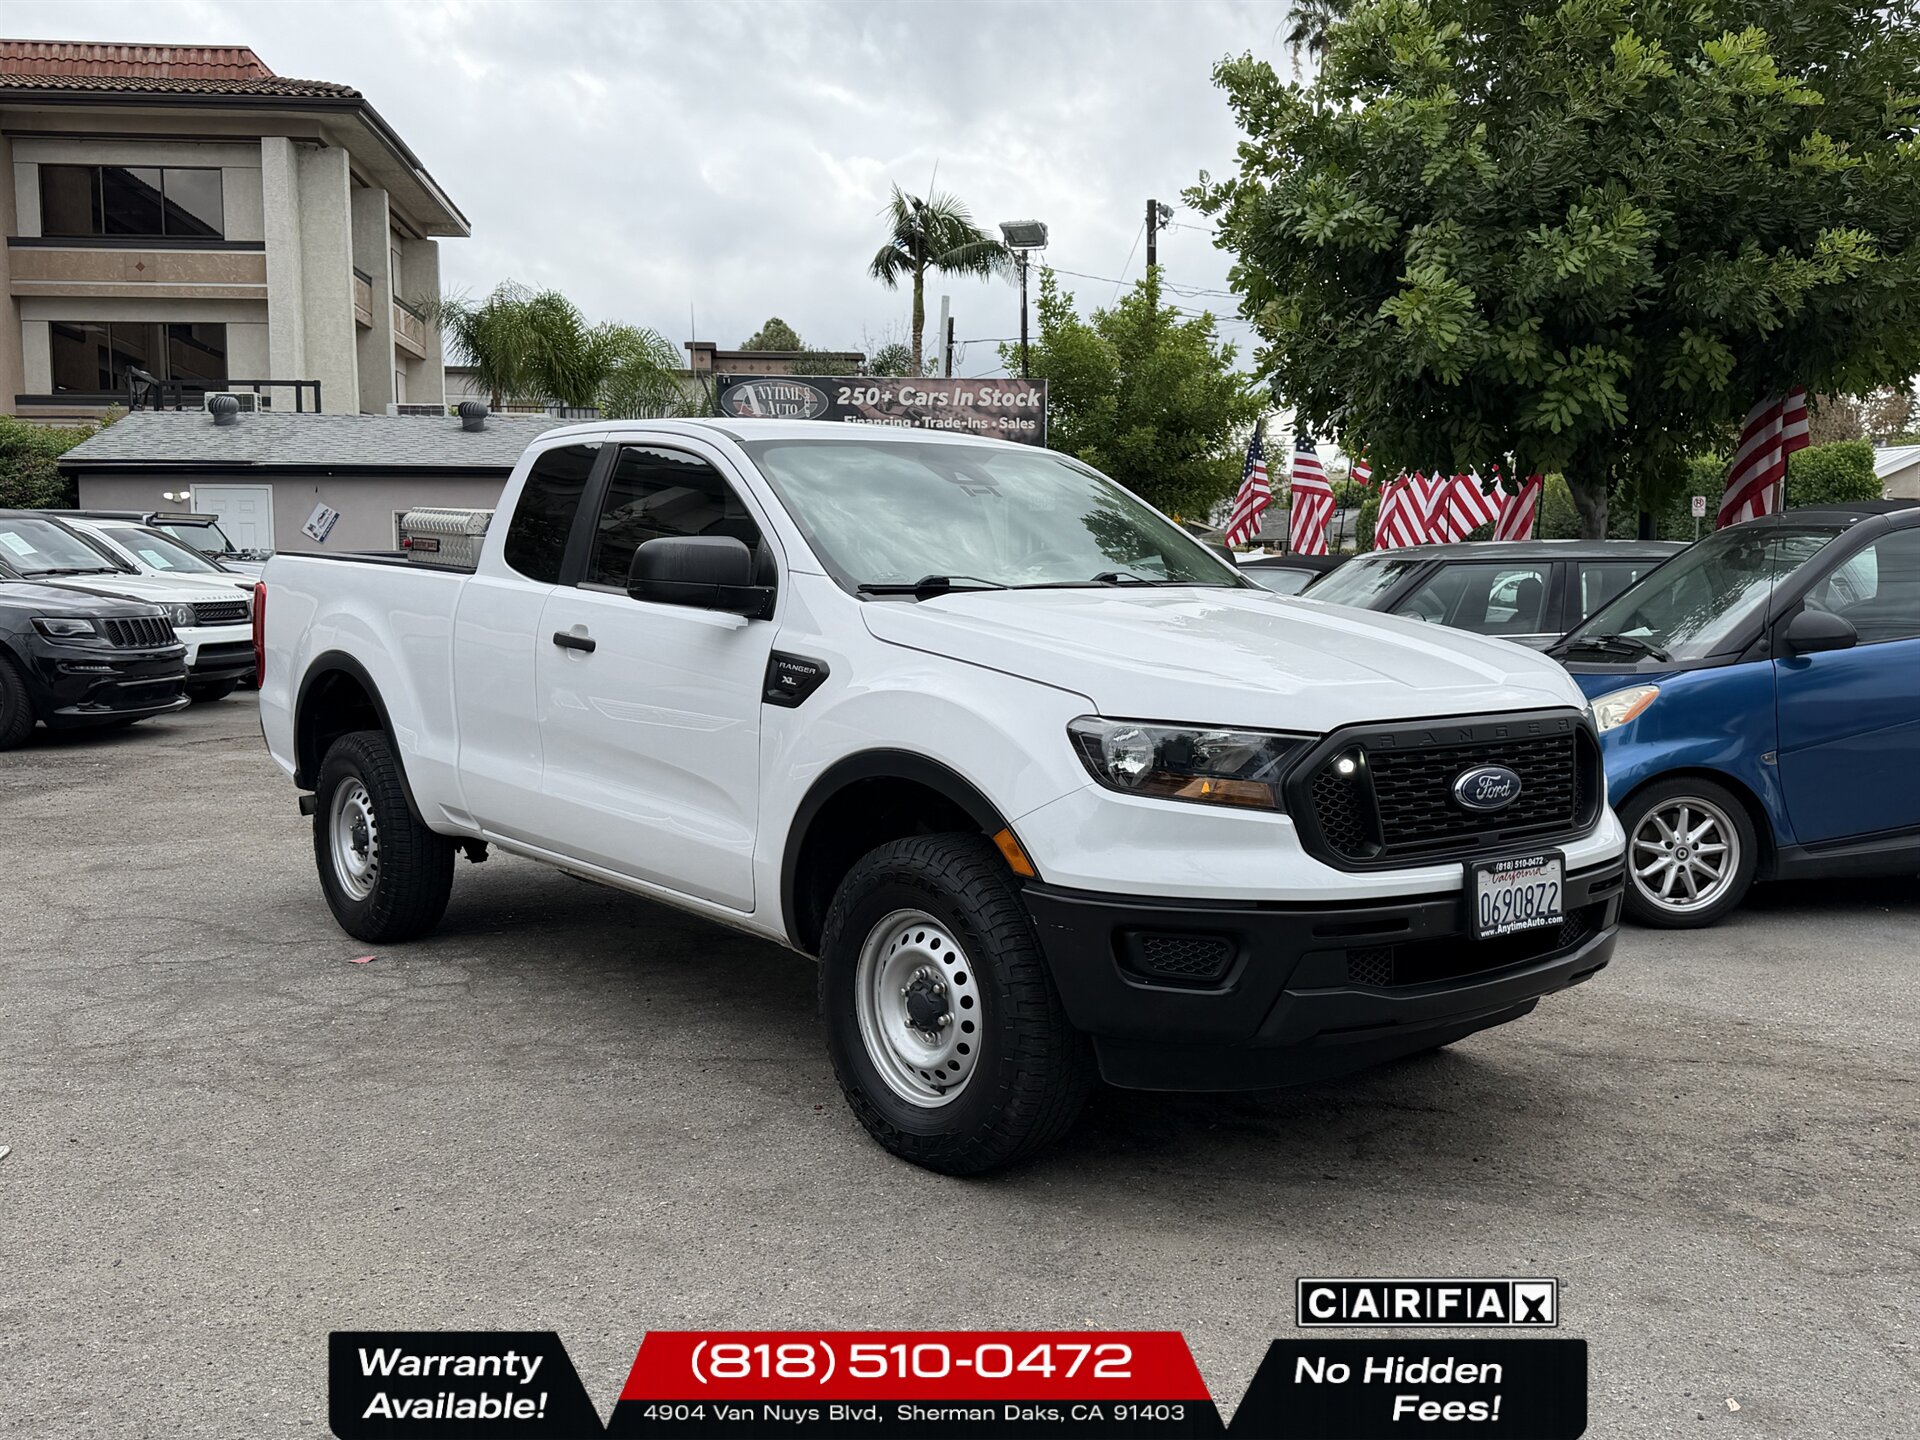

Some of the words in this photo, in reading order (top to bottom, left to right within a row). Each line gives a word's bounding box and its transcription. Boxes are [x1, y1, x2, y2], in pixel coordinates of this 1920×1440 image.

[837, 386, 893, 406] 250+
[899, 386, 949, 406] Cars
[953, 387, 973, 406] In
[977, 387, 1041, 407] Stock
[767, 401, 798, 415] AUTO
[922, 417, 988, 429] Trade-Ins
[999, 417, 1036, 429] Sales
[778, 662, 816, 675] RANGER
[781, 675, 797, 686] XL
[1378, 718, 1570, 748] RANGER
[1476, 775, 1511, 800] Ford
[1480, 915, 1564, 938] www.AnytimeAuto.com
